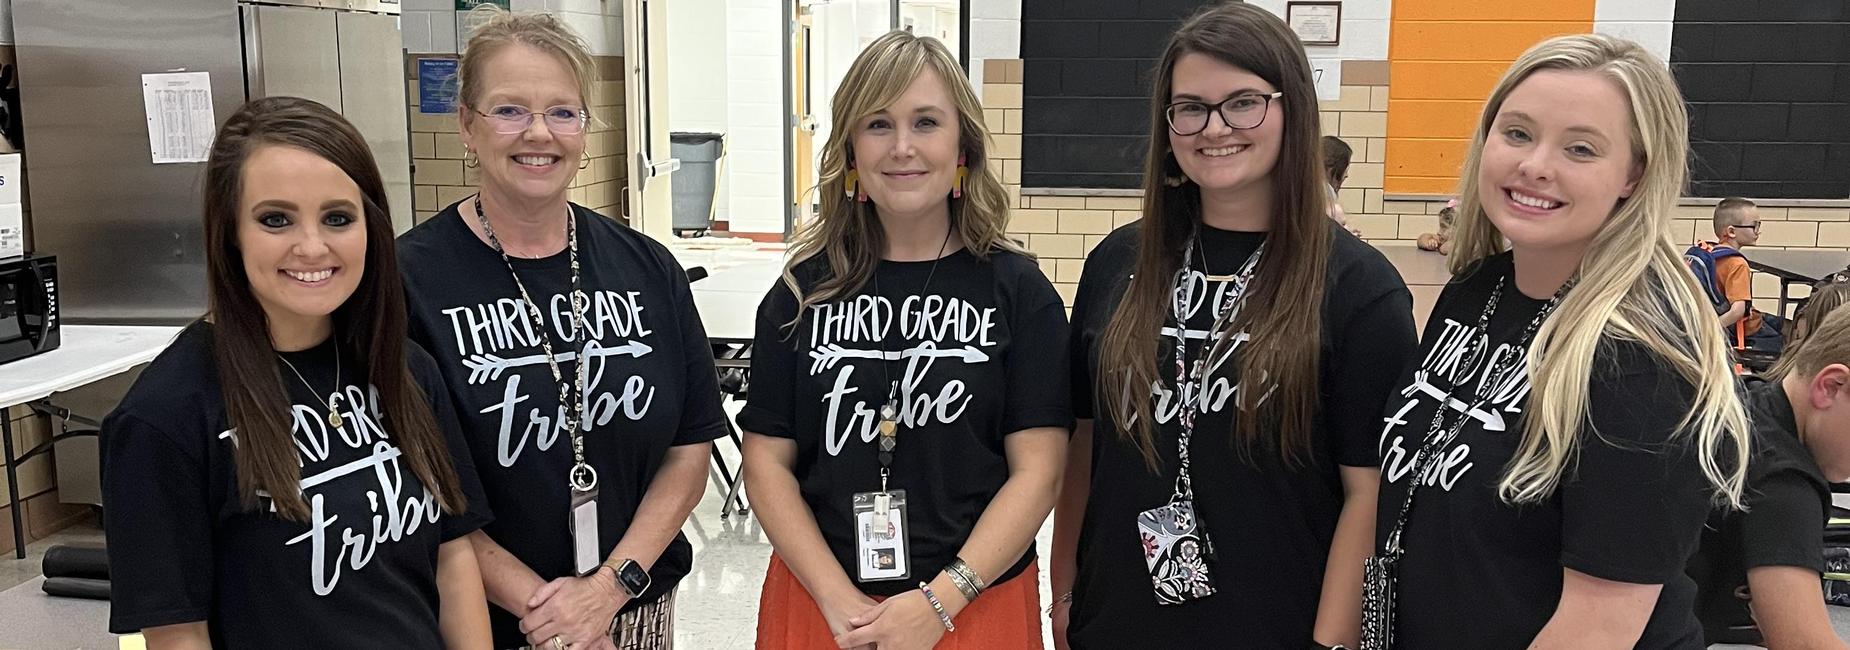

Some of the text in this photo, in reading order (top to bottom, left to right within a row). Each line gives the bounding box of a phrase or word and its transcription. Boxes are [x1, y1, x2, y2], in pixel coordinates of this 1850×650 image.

[441, 290, 653, 357] THIRD GRADE
[808, 294, 998, 349] THIRD GRADE
[479, 339, 656, 468] tribe
